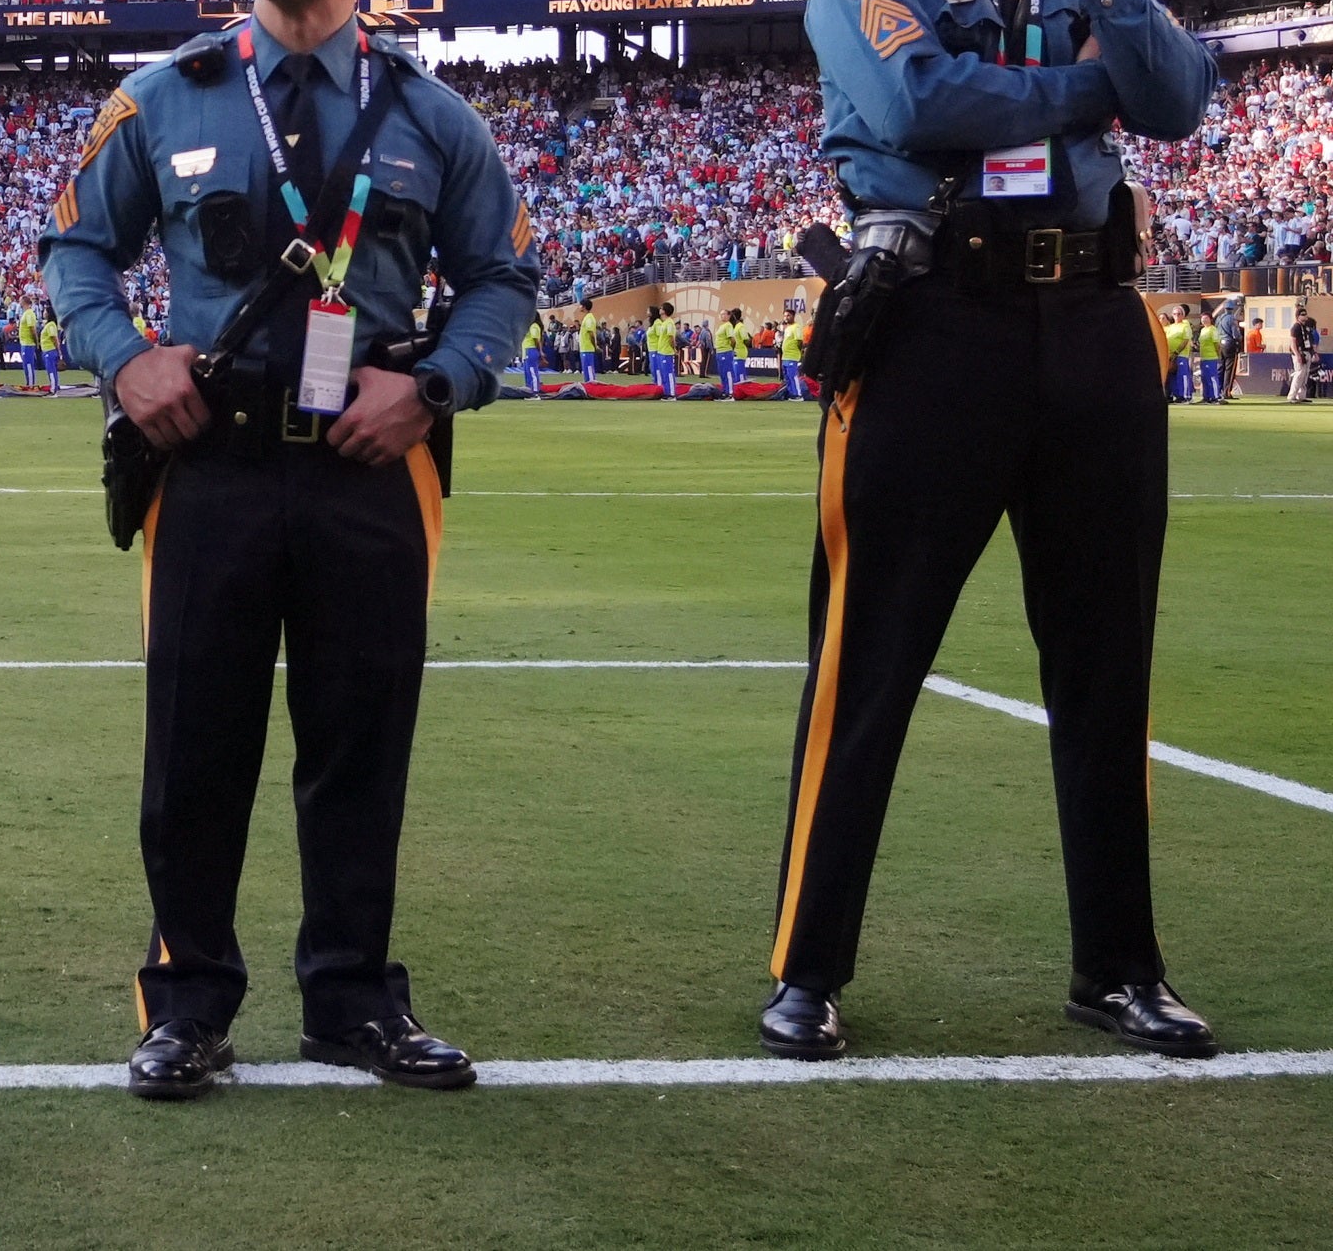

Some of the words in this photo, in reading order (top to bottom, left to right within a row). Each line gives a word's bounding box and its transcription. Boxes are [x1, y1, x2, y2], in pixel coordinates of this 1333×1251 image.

[549, 0, 581, 13] FIFA
[4, 11, 46, 26] THE
[49, 10, 111, 26] FINAL
[245, 64, 262, 98] 2026
[253, 97, 268, 116] CUP
[260, 115, 279, 151] WORLD
[271, 149, 287, 173] FIFA
[783, 298, 807, 314] FIFA
